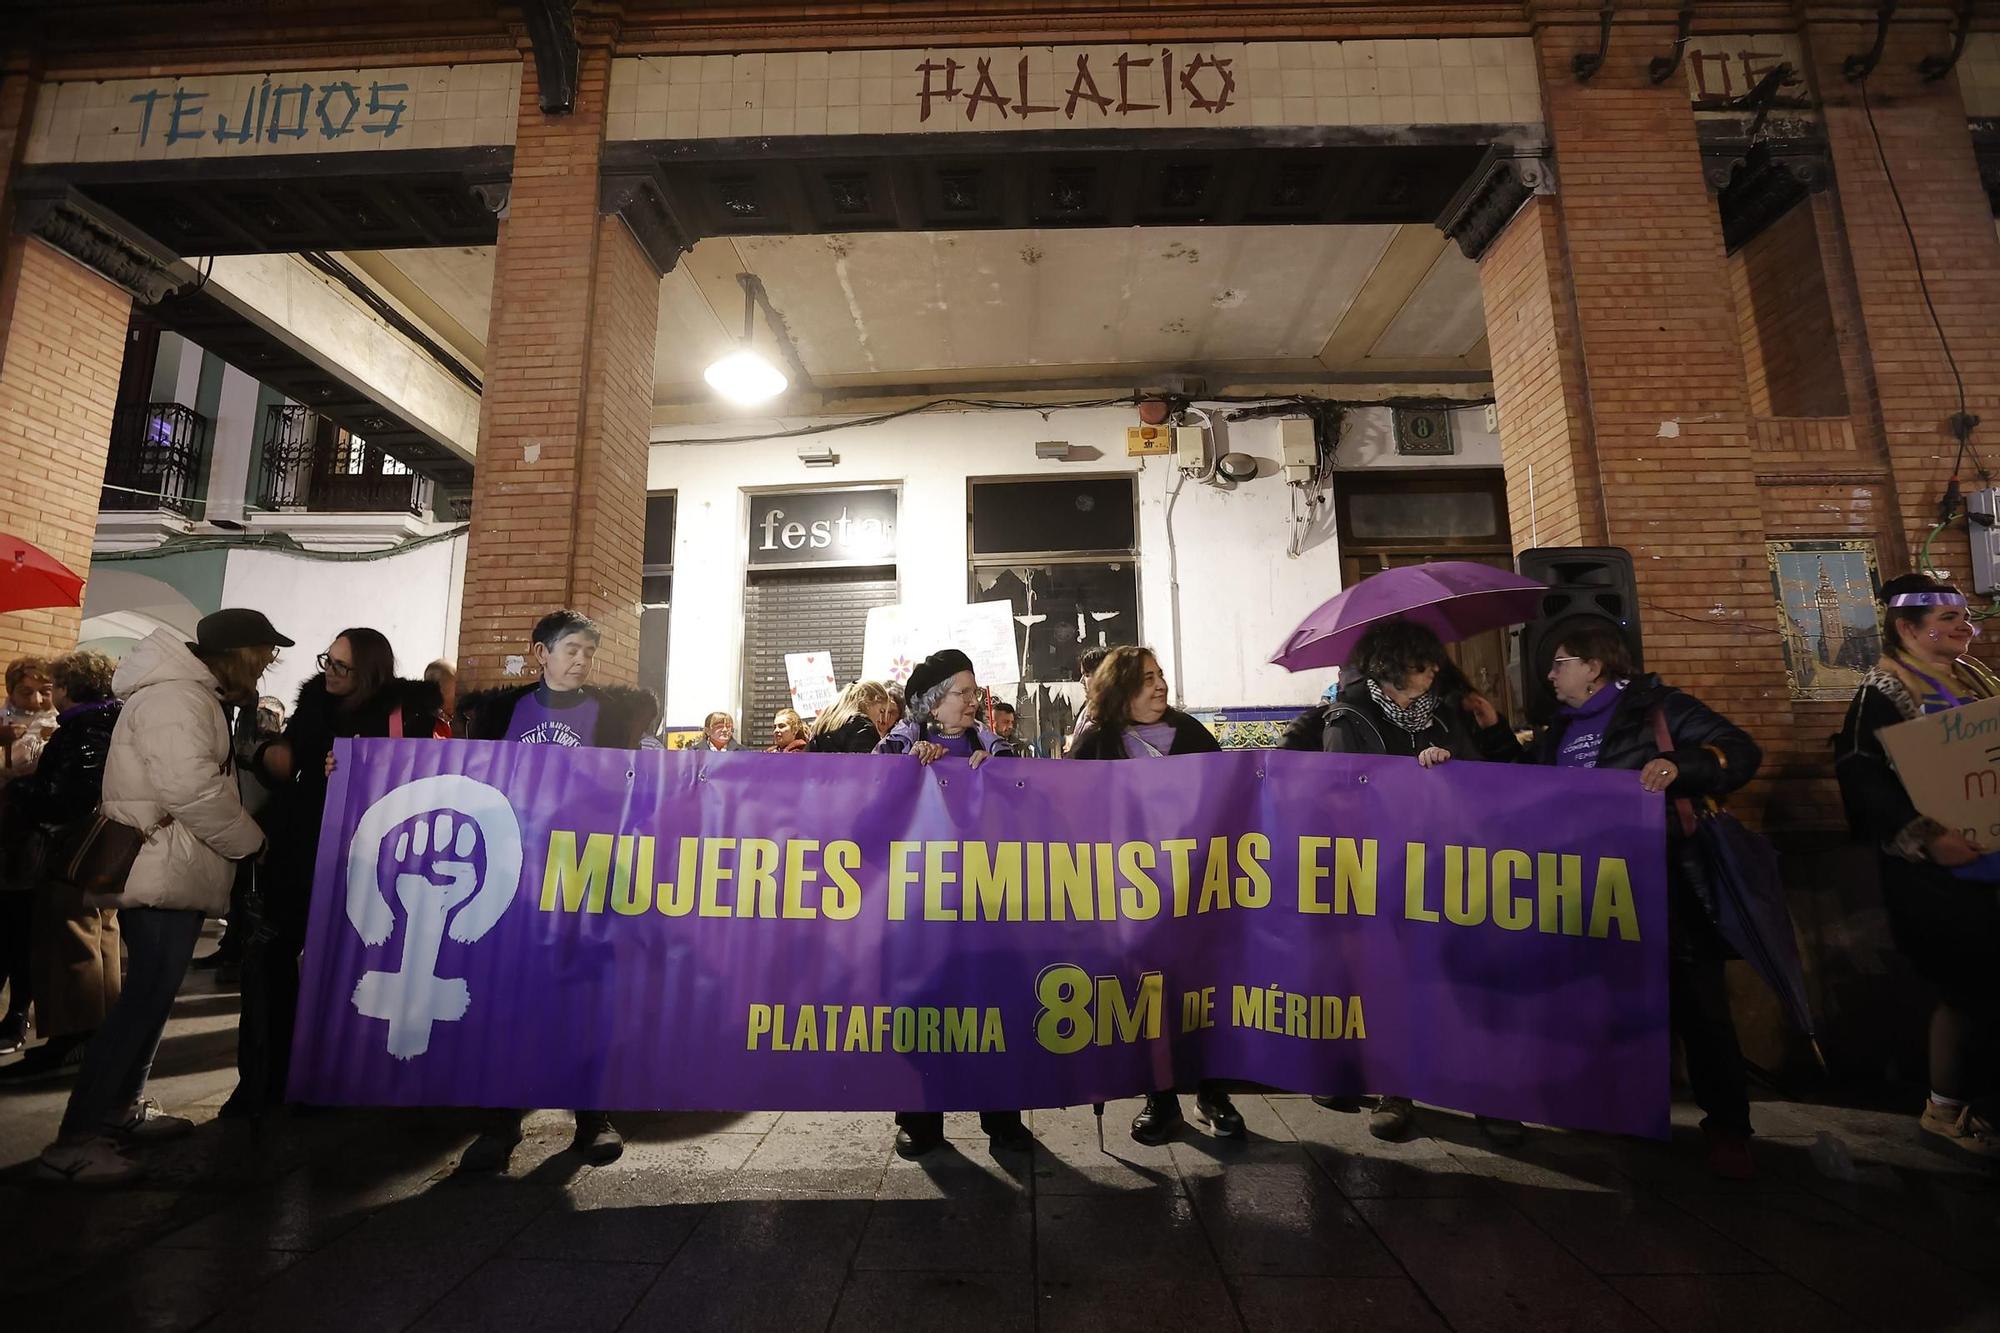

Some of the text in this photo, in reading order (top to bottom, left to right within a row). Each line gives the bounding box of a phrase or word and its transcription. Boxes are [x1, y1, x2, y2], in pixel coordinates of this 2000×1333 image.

[129, 78, 408, 147] TEJIDOS
[914, 48, 1235, 122] PALACIO
[1417, 417, 1428, 437] 8
[759, 506, 889, 550] festa
[1939, 711, 2000, 744] Hom
[540, 830, 1640, 941] MUJERES FEMINISTAS EN LUCHA
[747, 963, 1366, 1054] PLATAFORMA 8M DE MÉRIDA
